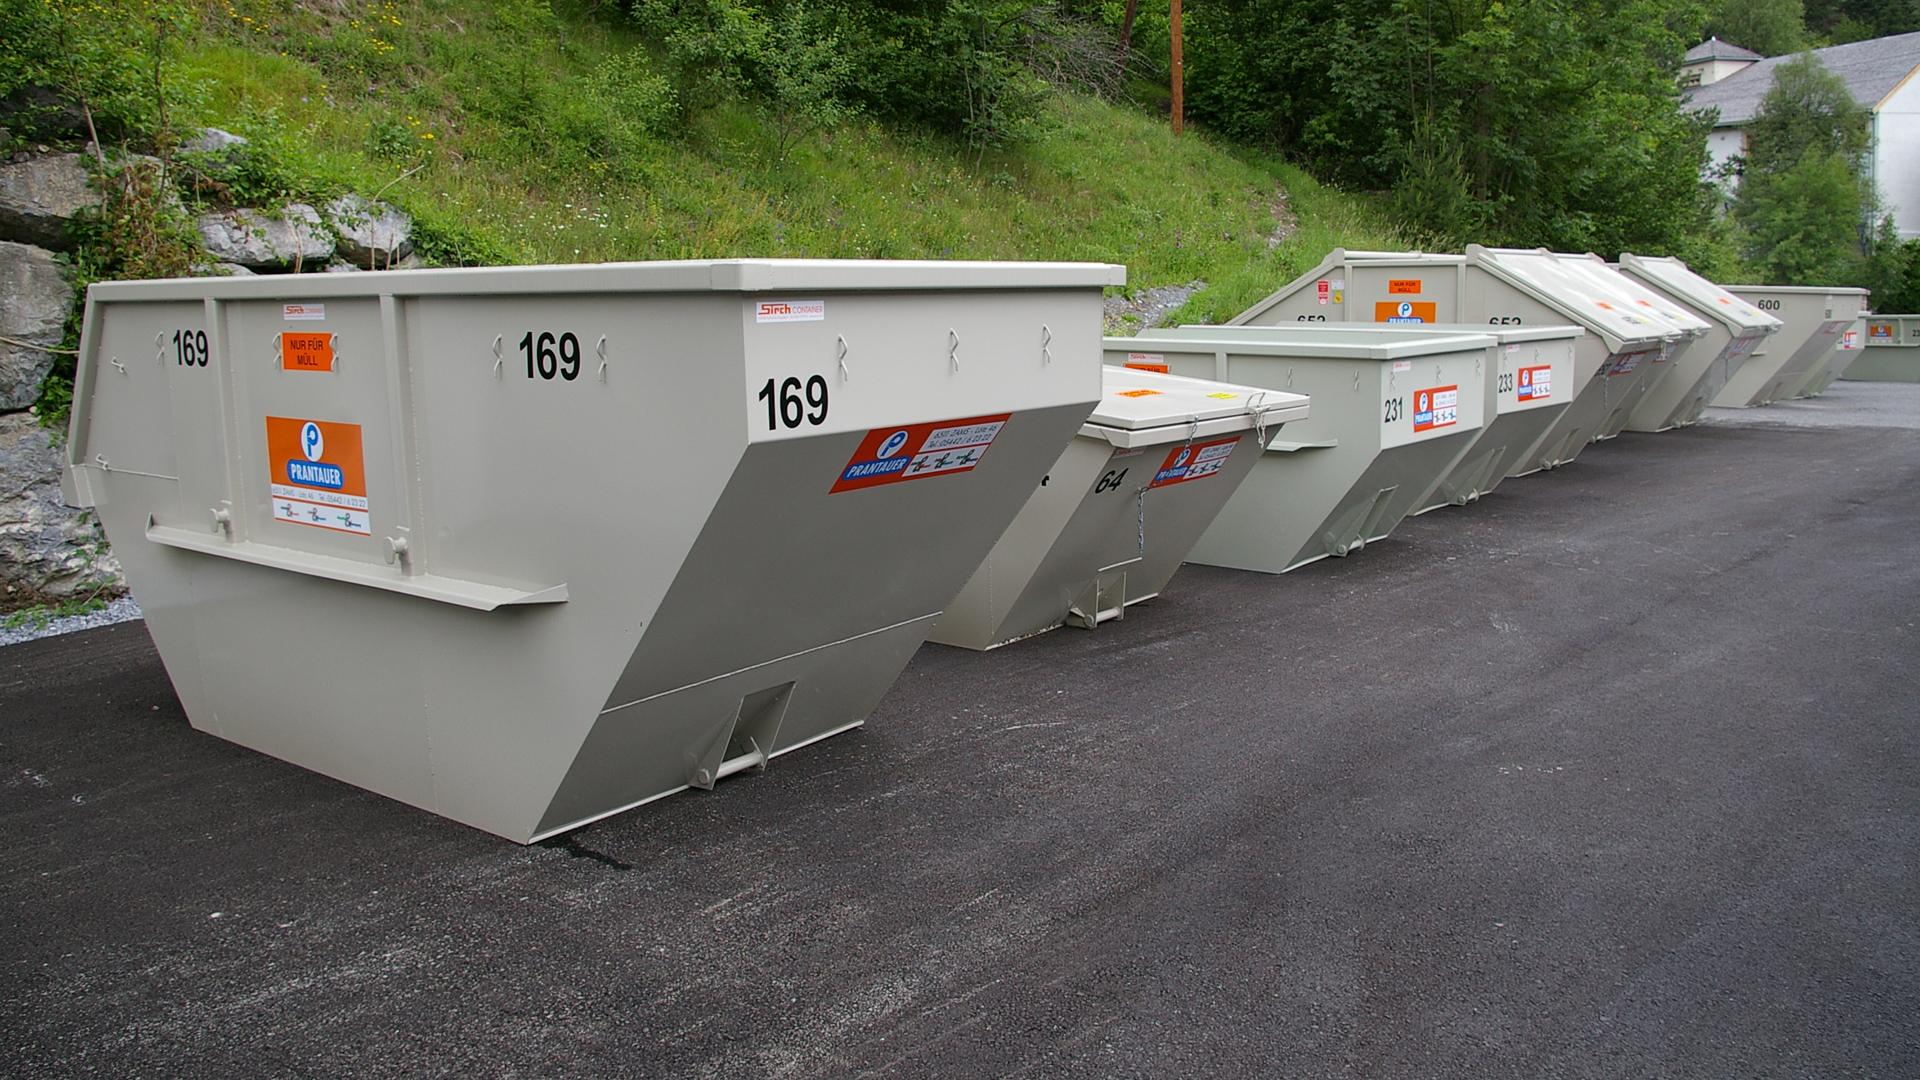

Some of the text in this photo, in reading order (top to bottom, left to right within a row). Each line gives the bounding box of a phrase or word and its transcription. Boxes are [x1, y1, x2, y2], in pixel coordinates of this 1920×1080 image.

[1758, 299, 1780, 310] 600
[173, 329, 209, 367] 169
[290, 338, 323, 350] NUR FÜR
[297, 353, 318, 366] MÜLL
[519, 331, 581, 381] 169
[1498, 373, 1513, 393] 233
[759, 374, 829, 431] 169
[1384, 396, 1403, 423] 231
[290, 463, 342, 485] PRANTAUER
[847, 458, 908, 478] PRANTAUER
[1095, 467, 1129, 494] 64
